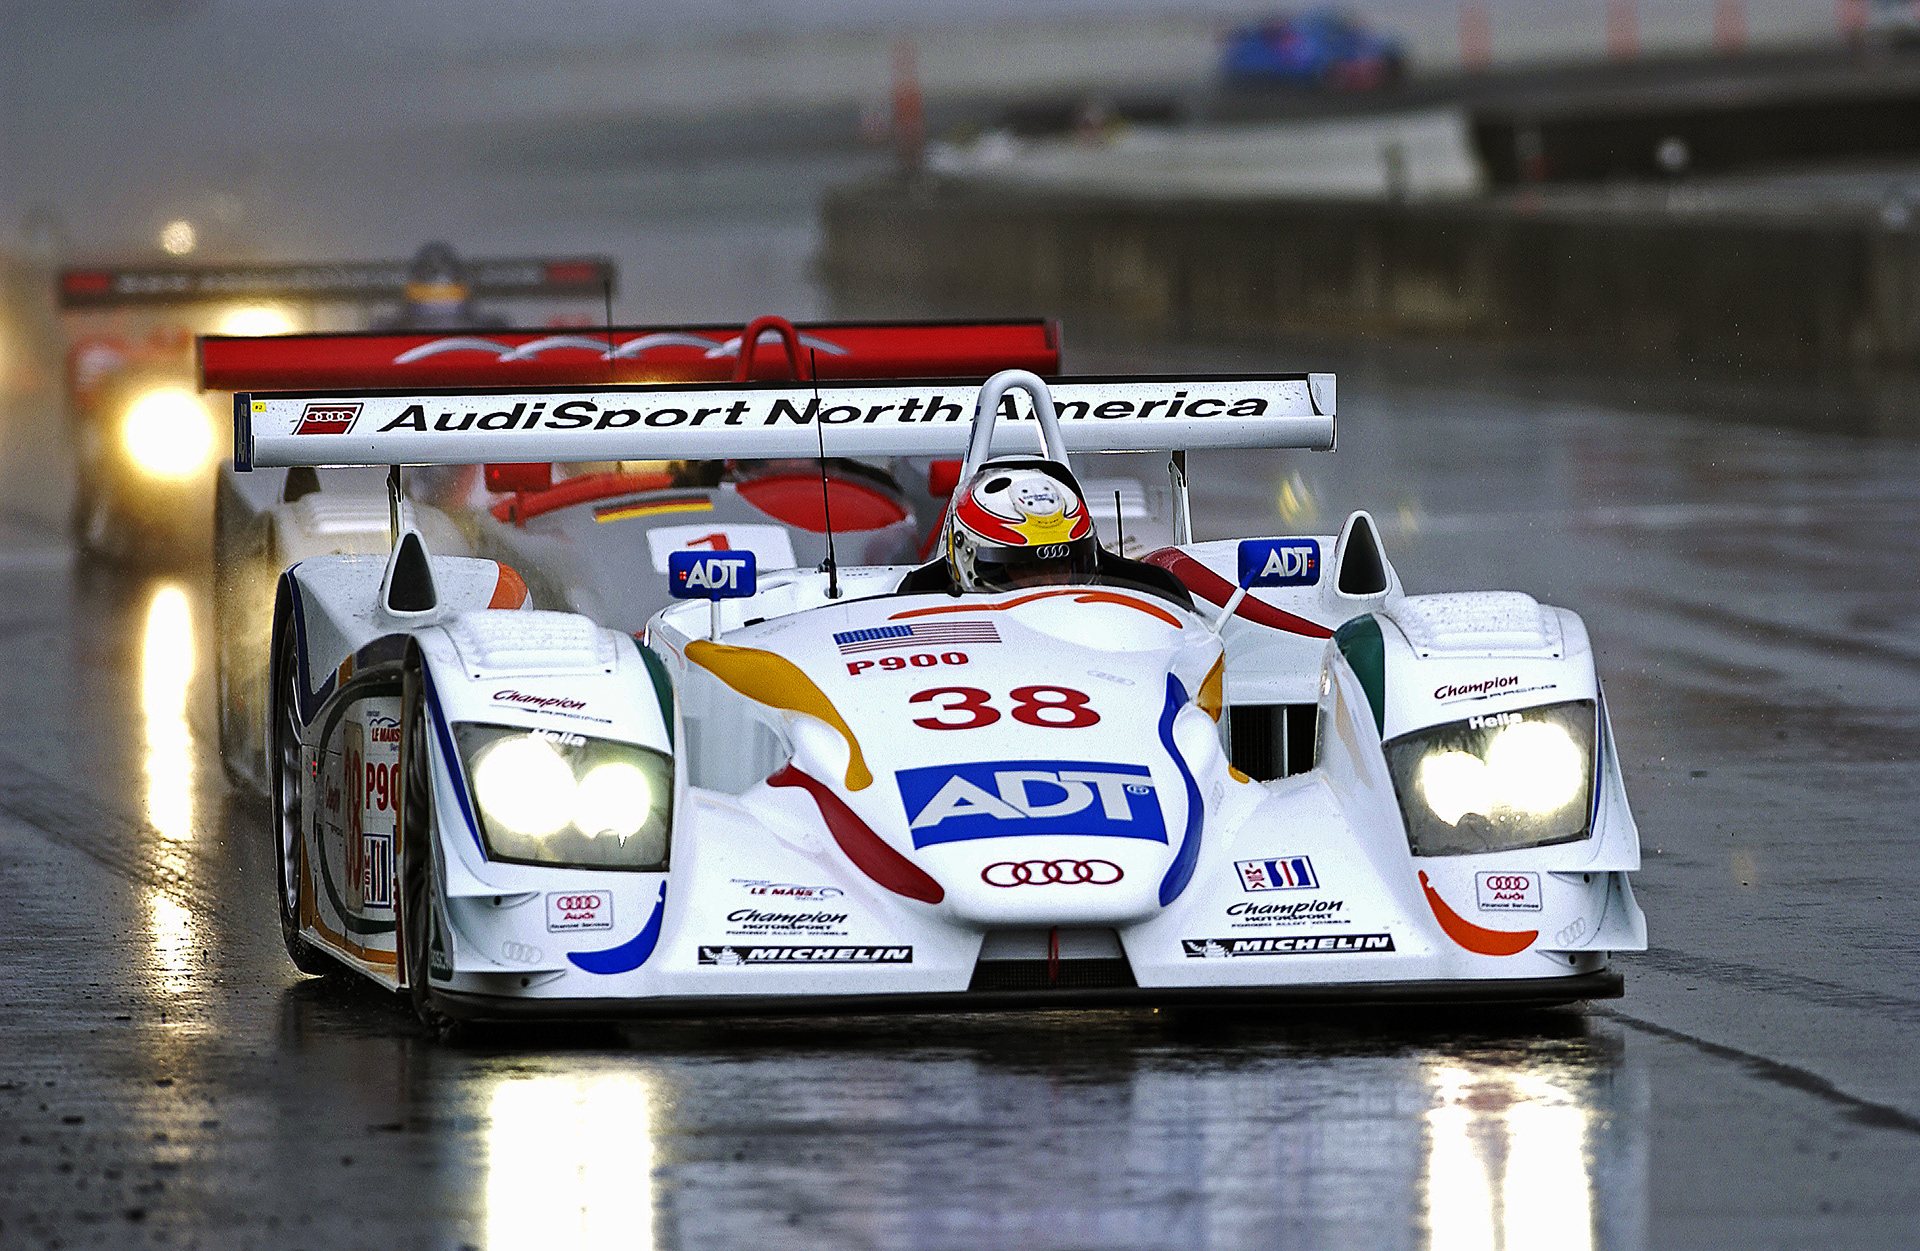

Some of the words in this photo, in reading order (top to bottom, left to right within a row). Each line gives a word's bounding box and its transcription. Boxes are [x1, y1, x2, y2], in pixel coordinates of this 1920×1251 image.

[377, 401, 751, 432] AudiSport
[764, 396, 962, 425] North
[971, 392, 1268, 421] America
[1260, 546, 1312, 577] ADT
[685, 559, 746, 589] ADT
[846, 651, 969, 677] P900
[1434, 675, 1519, 700] Champion
[492, 689, 587, 710] Champion
[908, 685, 1101, 730] 38
[909, 770, 1155, 831] ADT
[771, 888, 814, 896] MANS
[1494, 891, 1524, 900] Audi
[563, 912, 594, 920] Audi
[727, 909, 848, 928] Champion
[1226, 899, 1343, 917] Champion
[747, 949, 910, 960] MICHELIN
[1232, 936, 1390, 952] MICHELIN
